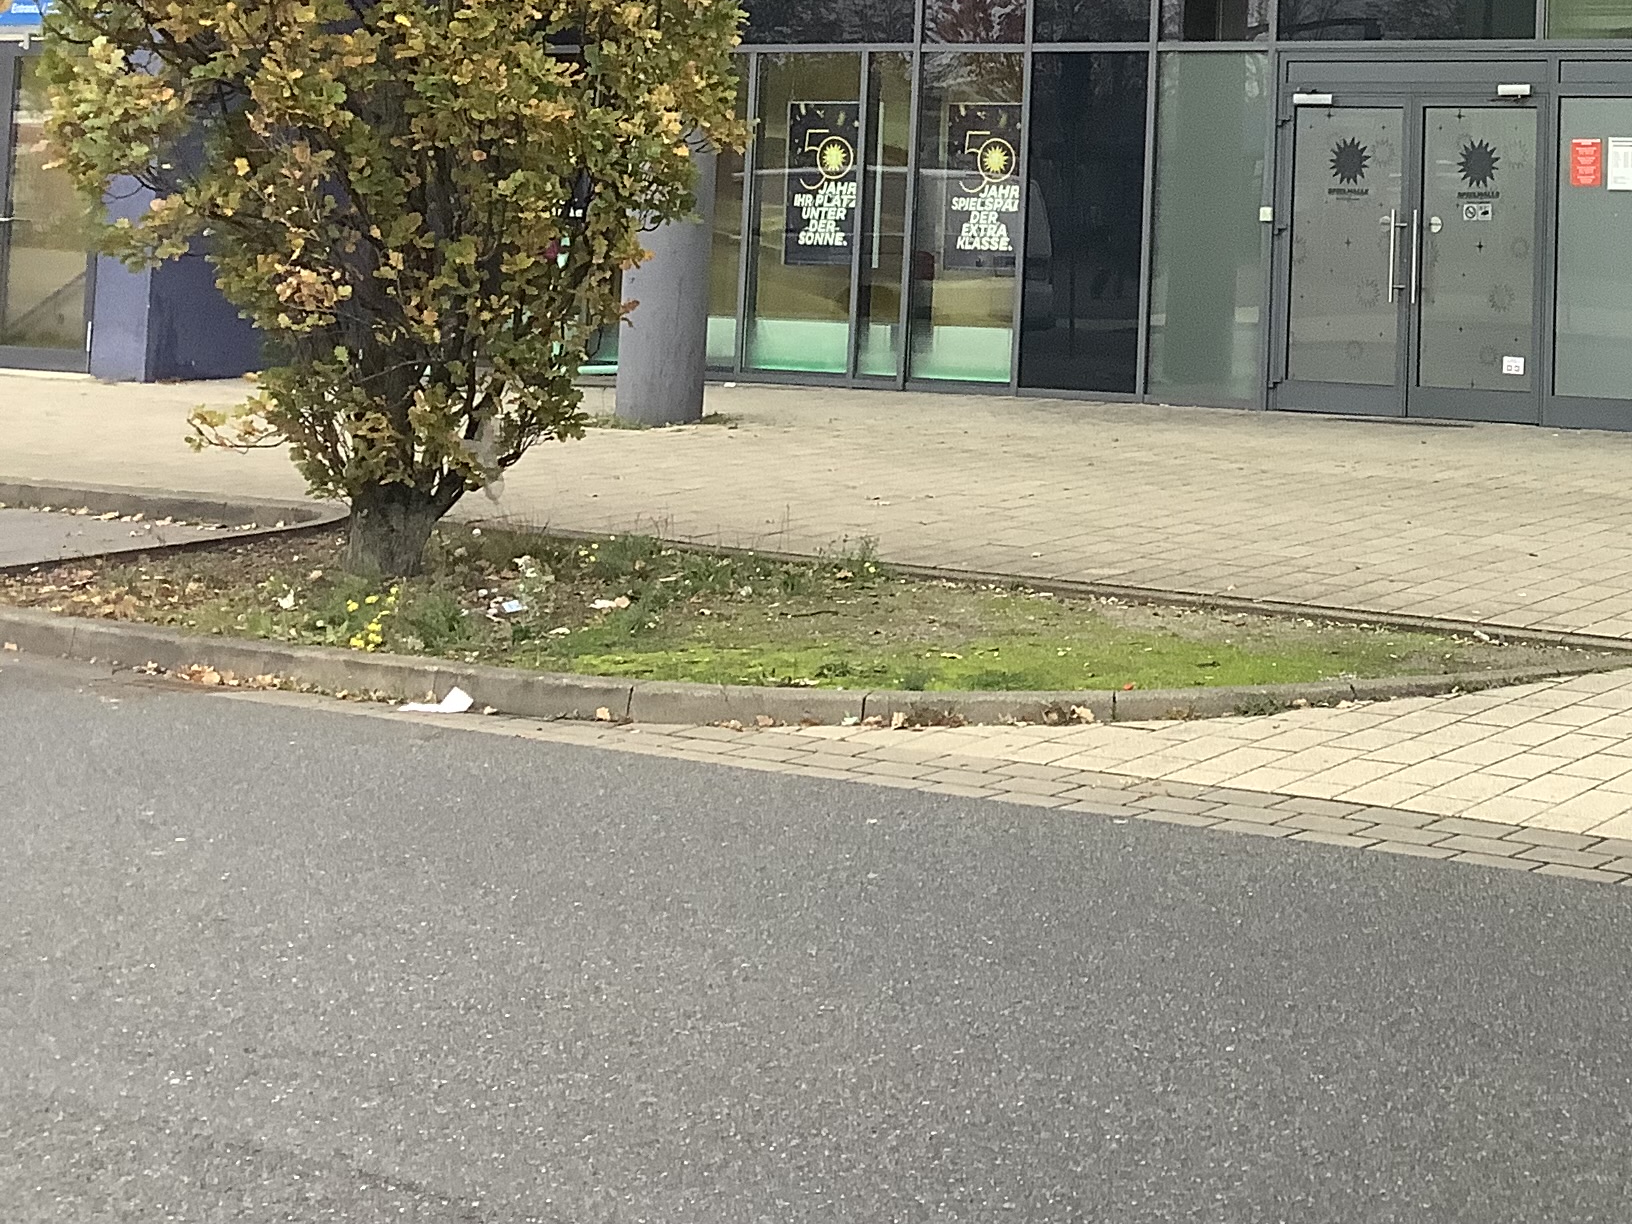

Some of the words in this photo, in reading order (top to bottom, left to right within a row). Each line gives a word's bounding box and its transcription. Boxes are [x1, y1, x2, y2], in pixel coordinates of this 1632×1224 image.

[818, 181, 857, 195] JAHR
[979, 185, 1019, 198] JAHR
[794, 194, 814, 207] IHR
[951, 197, 1019, 211] SPIELSPA
[802, 207, 846, 220] UNTER
[970, 211, 998, 224] DER
[809, 219, 836, 232] DER
[961, 223, 1008, 237] EXTRA
[798, 232, 847, 246] SONNE.
[956, 237, 1013, 251] KLASSE.
